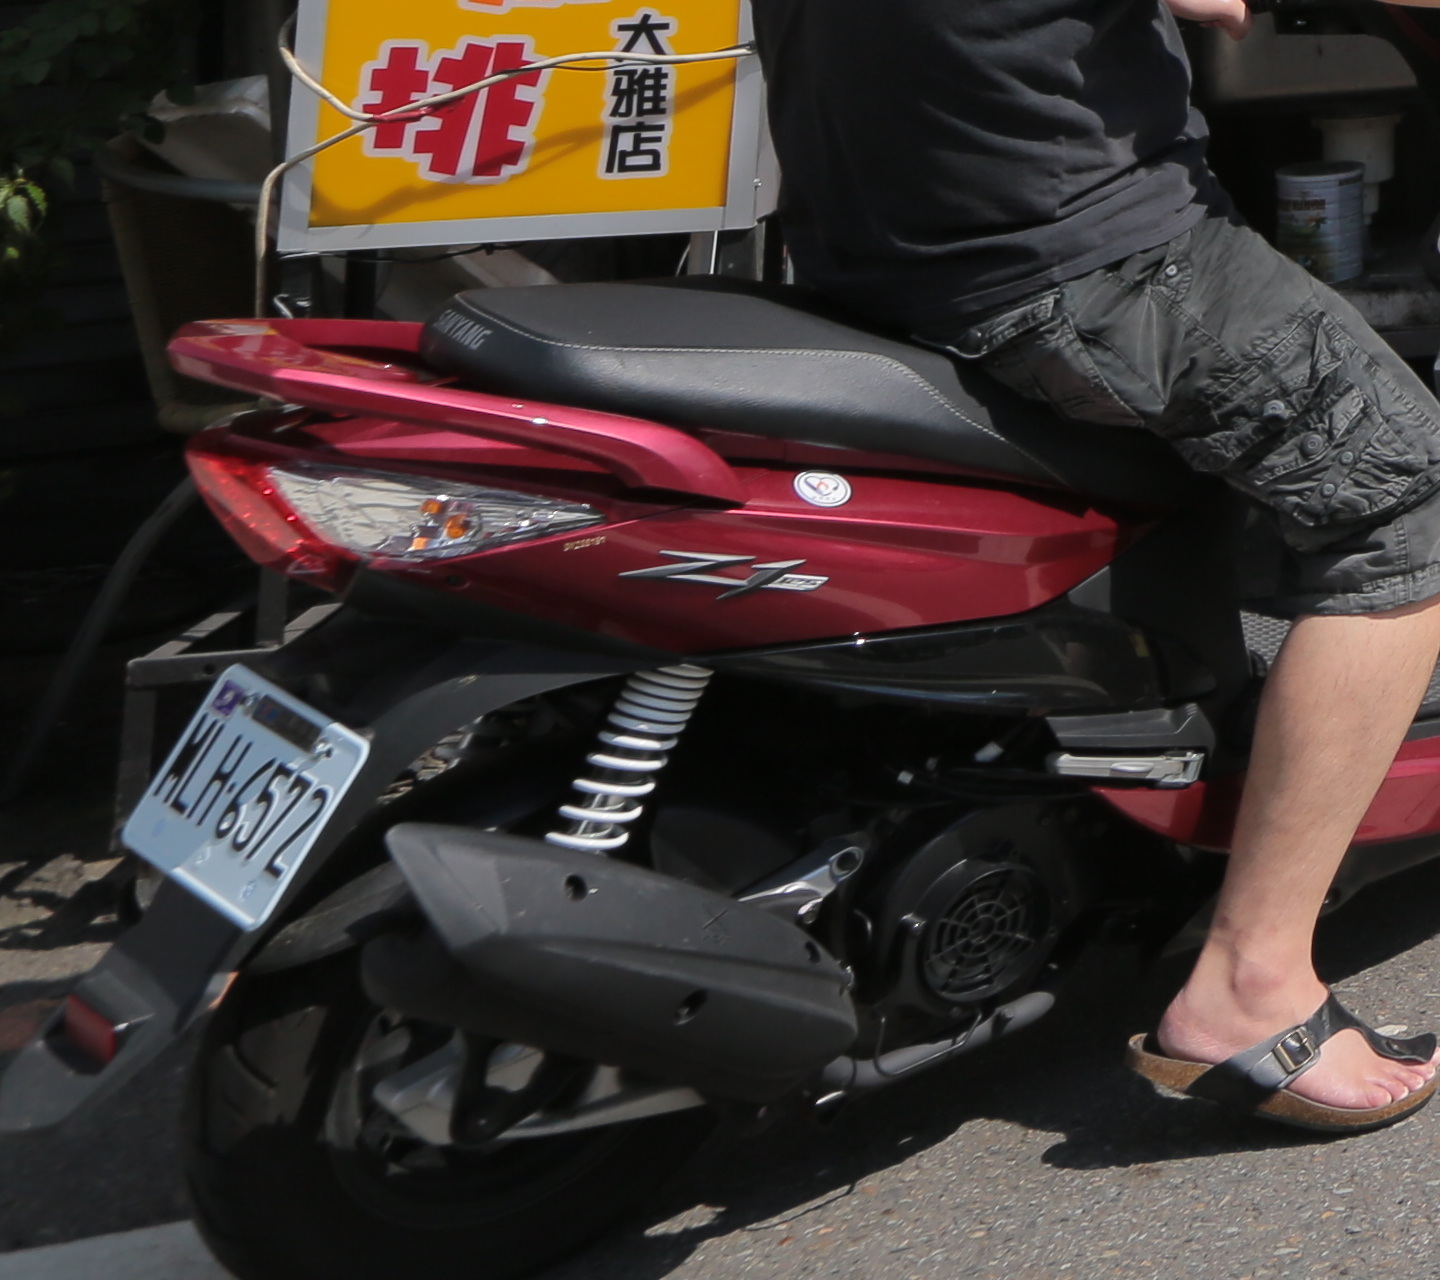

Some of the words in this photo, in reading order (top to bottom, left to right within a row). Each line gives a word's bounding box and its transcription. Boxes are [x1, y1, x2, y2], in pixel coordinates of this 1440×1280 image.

[603, 12, 671, 176] 大雅店
[152, 712, 331, 880] MLH-6572
